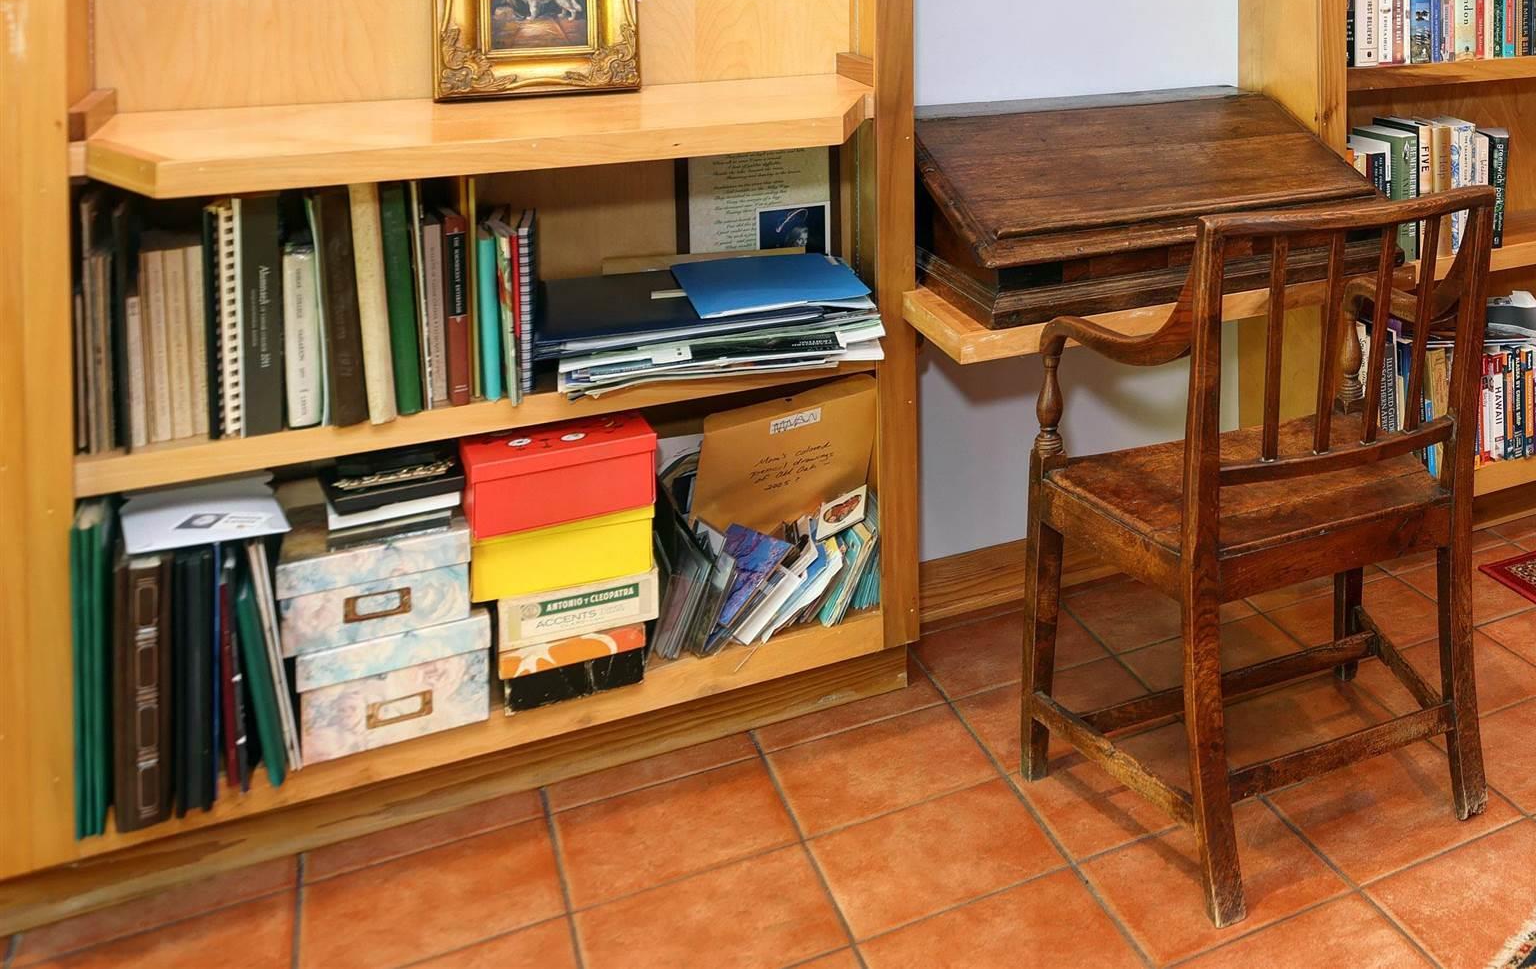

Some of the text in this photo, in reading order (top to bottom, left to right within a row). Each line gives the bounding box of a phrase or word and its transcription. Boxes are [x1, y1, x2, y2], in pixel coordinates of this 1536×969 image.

[1421, 146, 1430, 173] FIVE
[1495, 143, 1505, 205] greenwich park
[1380, 369, 1388, 409] SOUTHERN
[754, 441, 831, 467] Mom's colored
[793, 452, 834, 467] drawings
[546, 596, 582, 612] ANTONIO
[590, 586, 634, 602] CLEOPATRA
[536, 609, 597, 628] ACCENTS
